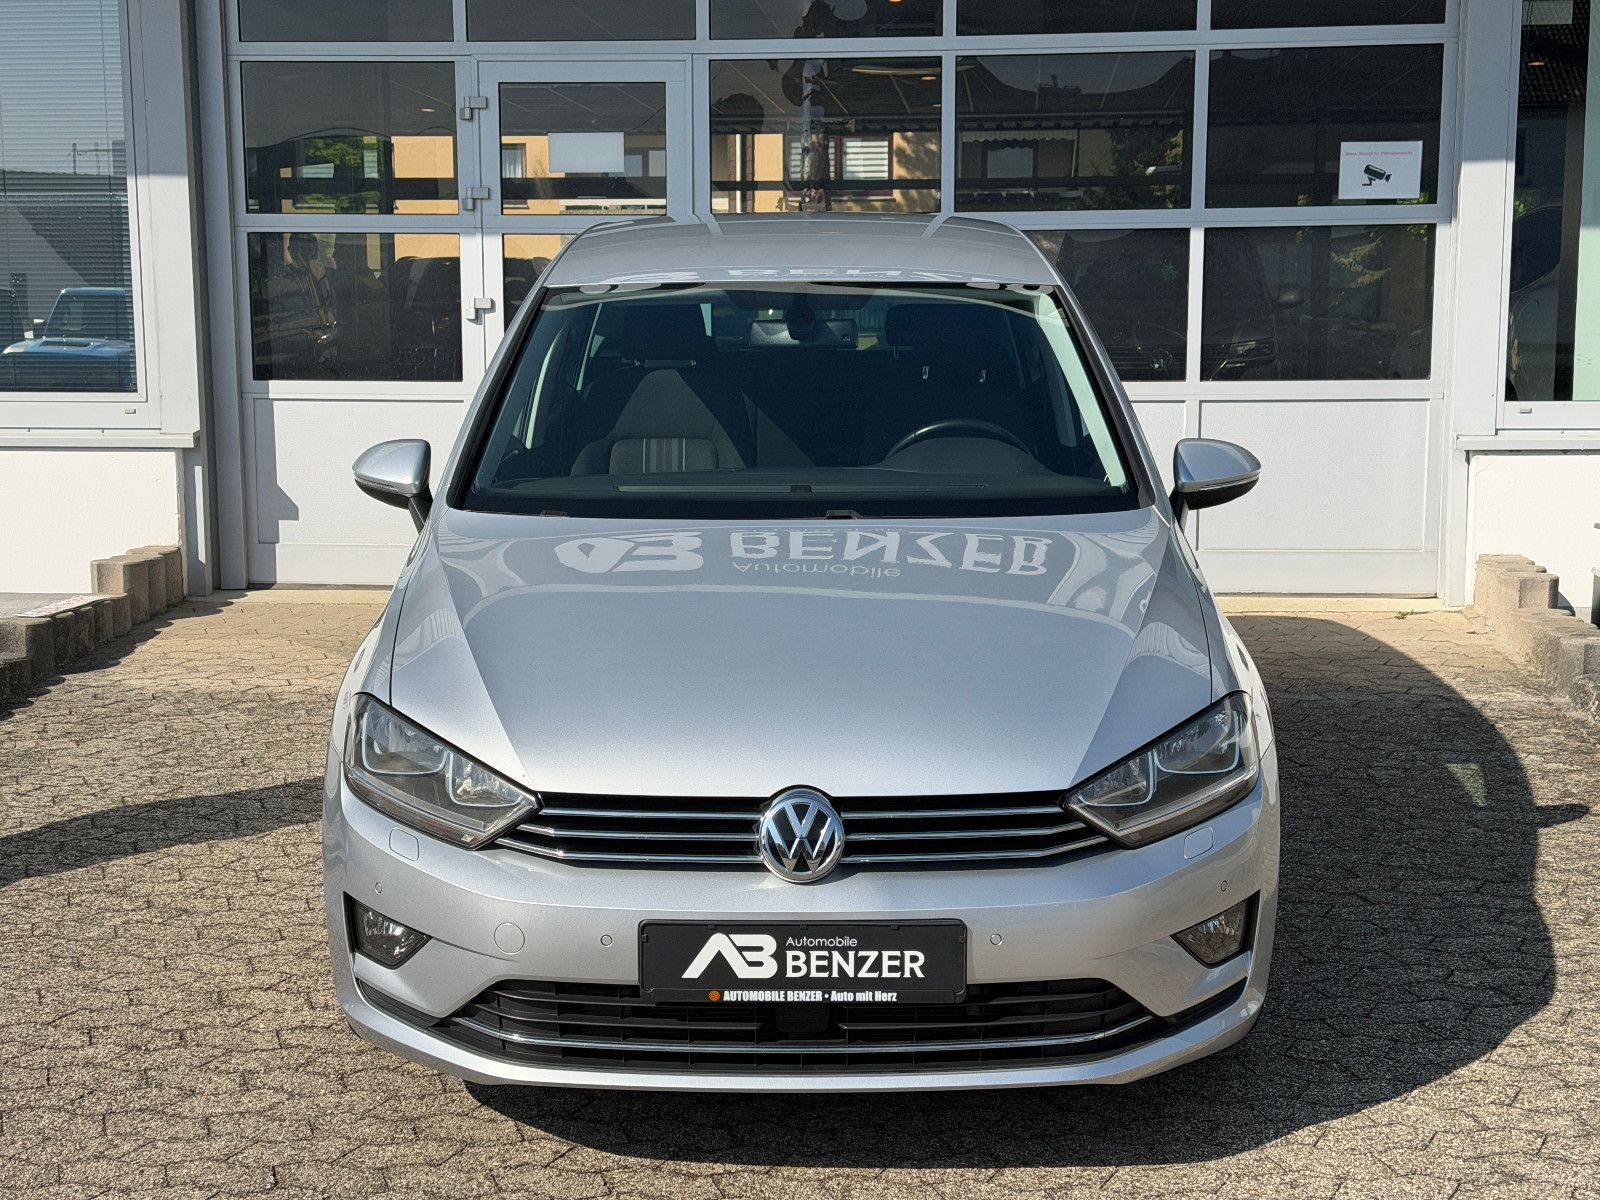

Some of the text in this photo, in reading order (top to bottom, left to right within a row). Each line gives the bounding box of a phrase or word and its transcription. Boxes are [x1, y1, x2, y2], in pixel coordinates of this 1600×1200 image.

[785, 936, 858, 948] Automobile
[785, 950, 925, 978] BENZER
[723, 990, 897, 1002] AUTOMOBILE BENZER Auto mit Herz
